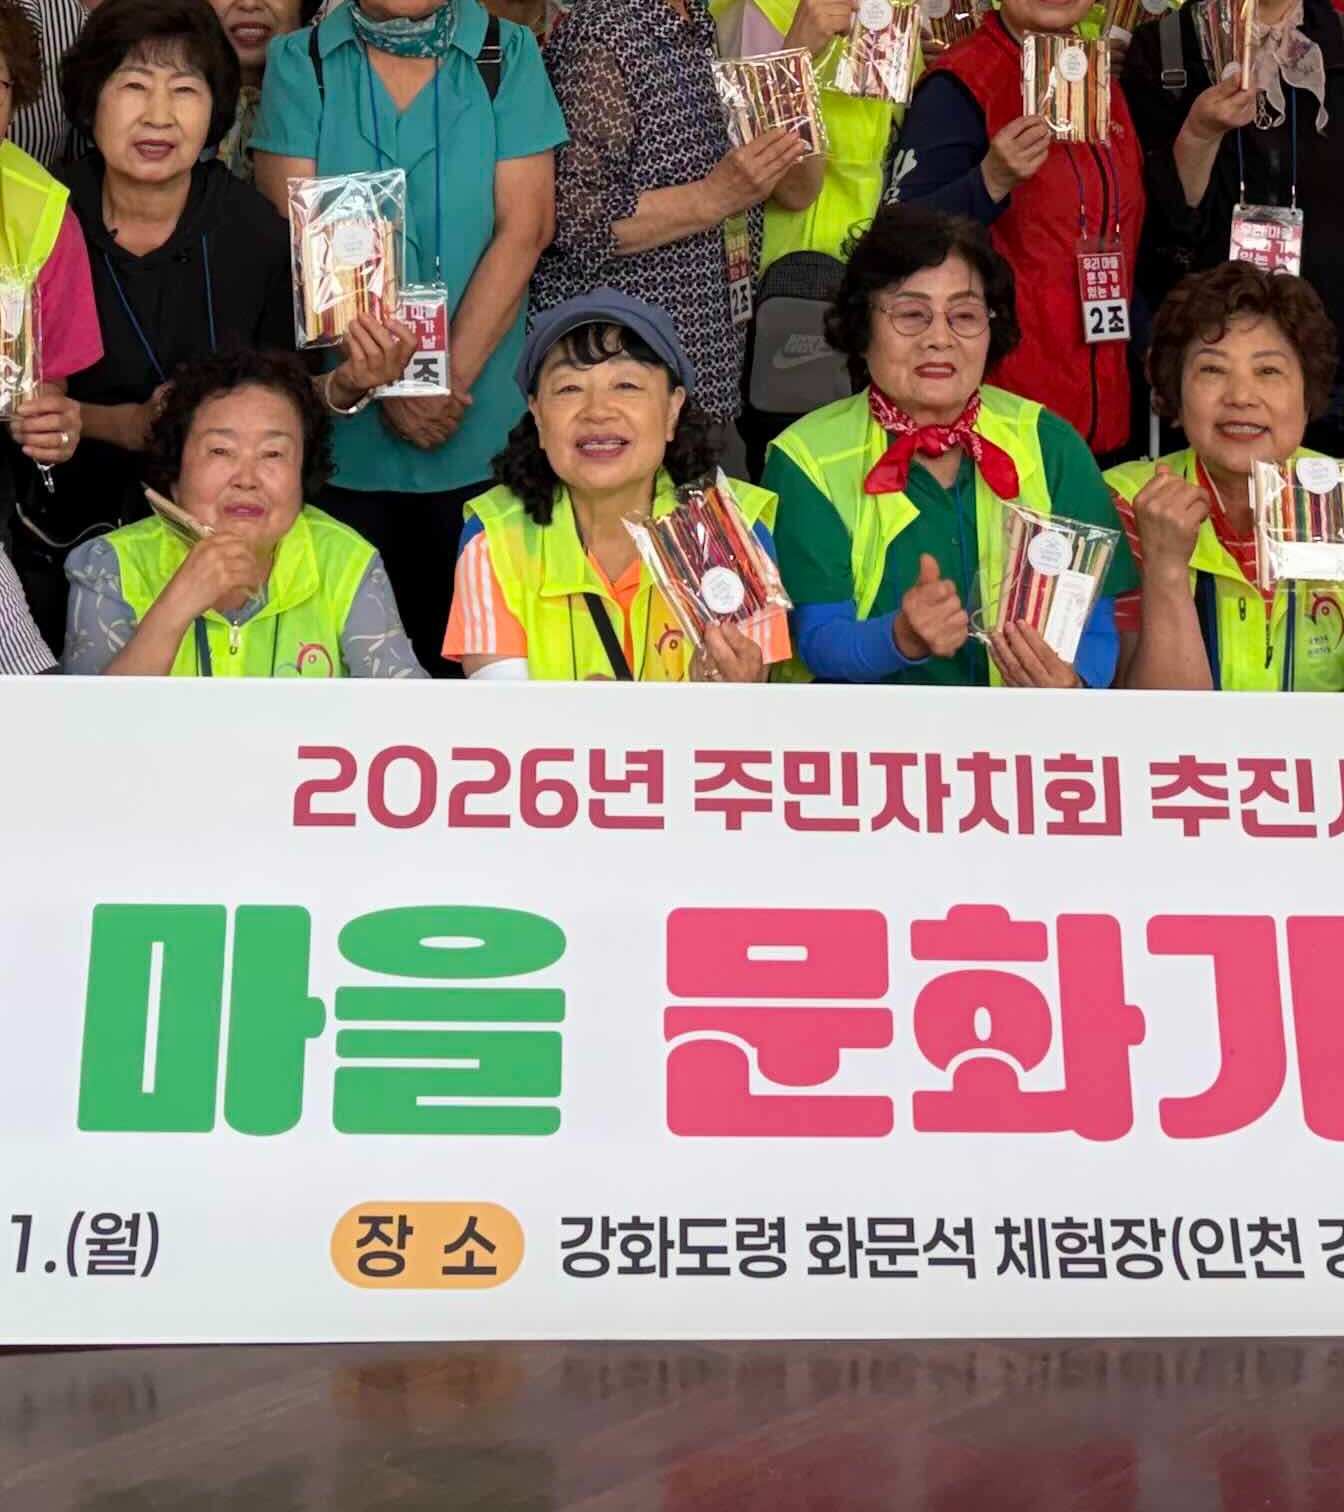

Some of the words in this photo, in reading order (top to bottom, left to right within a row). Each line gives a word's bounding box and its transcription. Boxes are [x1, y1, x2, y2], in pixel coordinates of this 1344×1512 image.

[1090, 306, 1125, 334] 2조
[293, 745, 664, 830] 2026년
[694, 750, 1122, 836] 주민자치회
[77, 904, 566, 1136] 마을
[355, 1212, 499, 1278] 장소
[561, 1216, 787, 1278] 강화도령
[806, 1216, 976, 1279] 화문석
[995, 1216, 1305, 1280] 체험장(인천
